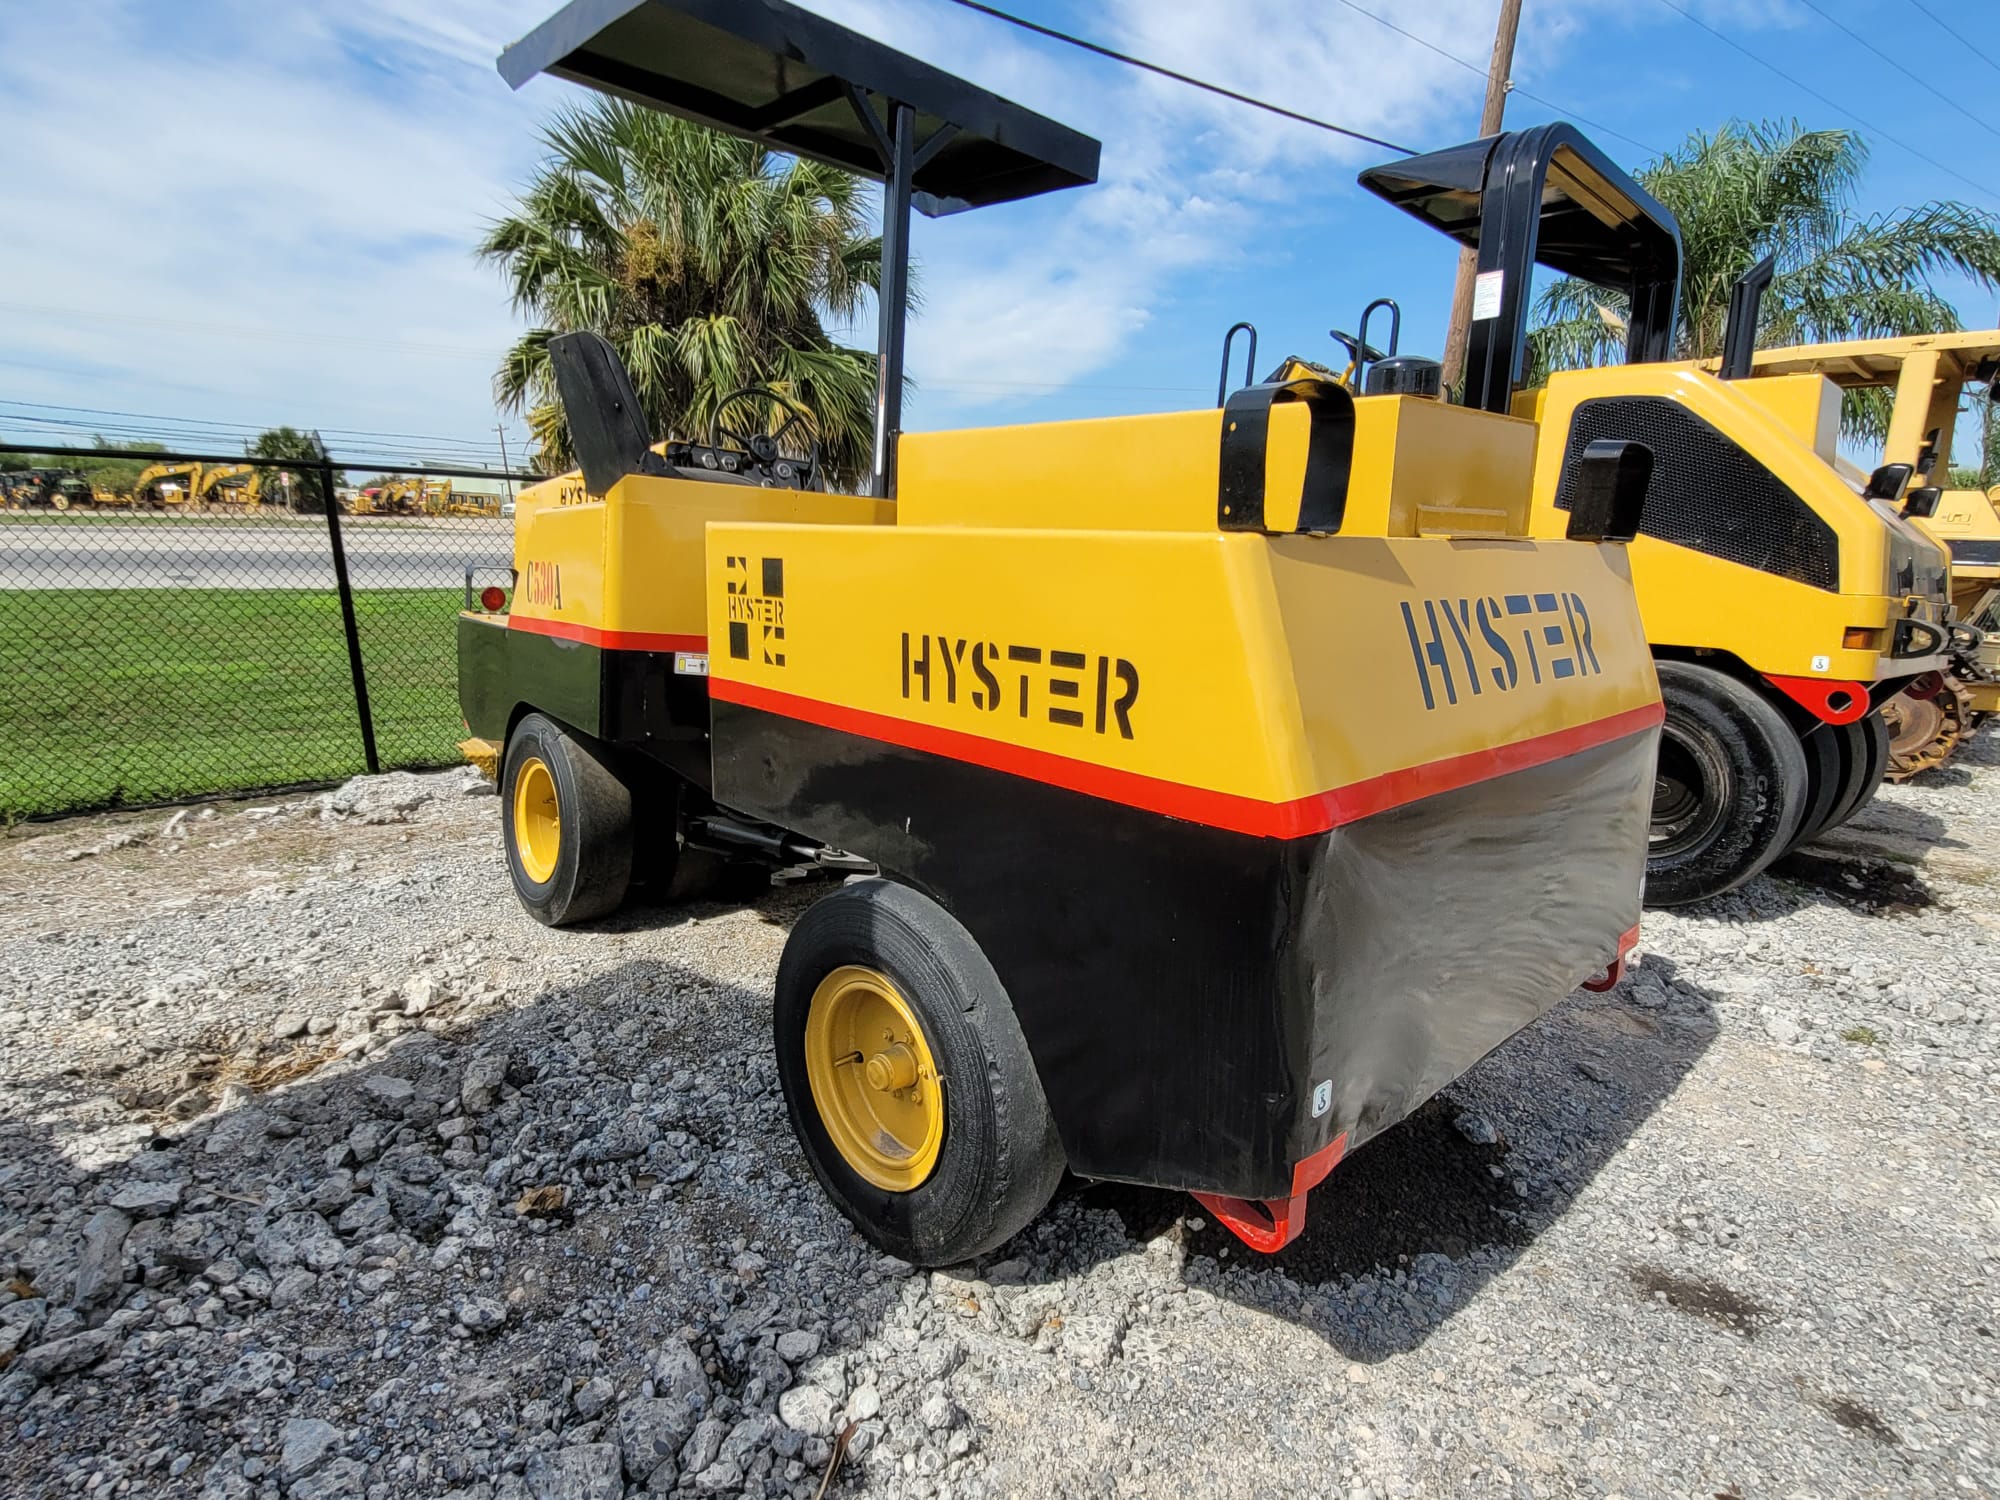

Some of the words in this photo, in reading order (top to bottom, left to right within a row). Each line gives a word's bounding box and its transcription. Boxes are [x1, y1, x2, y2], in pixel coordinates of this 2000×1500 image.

[560, 487, 606, 505] HYS
[526, 559, 562, 610] C530A
[727, 596, 785, 625] HYSTER
[1400, 592, 1601, 710] HYSTER
[901, 632, 1140, 740] HYSTER
